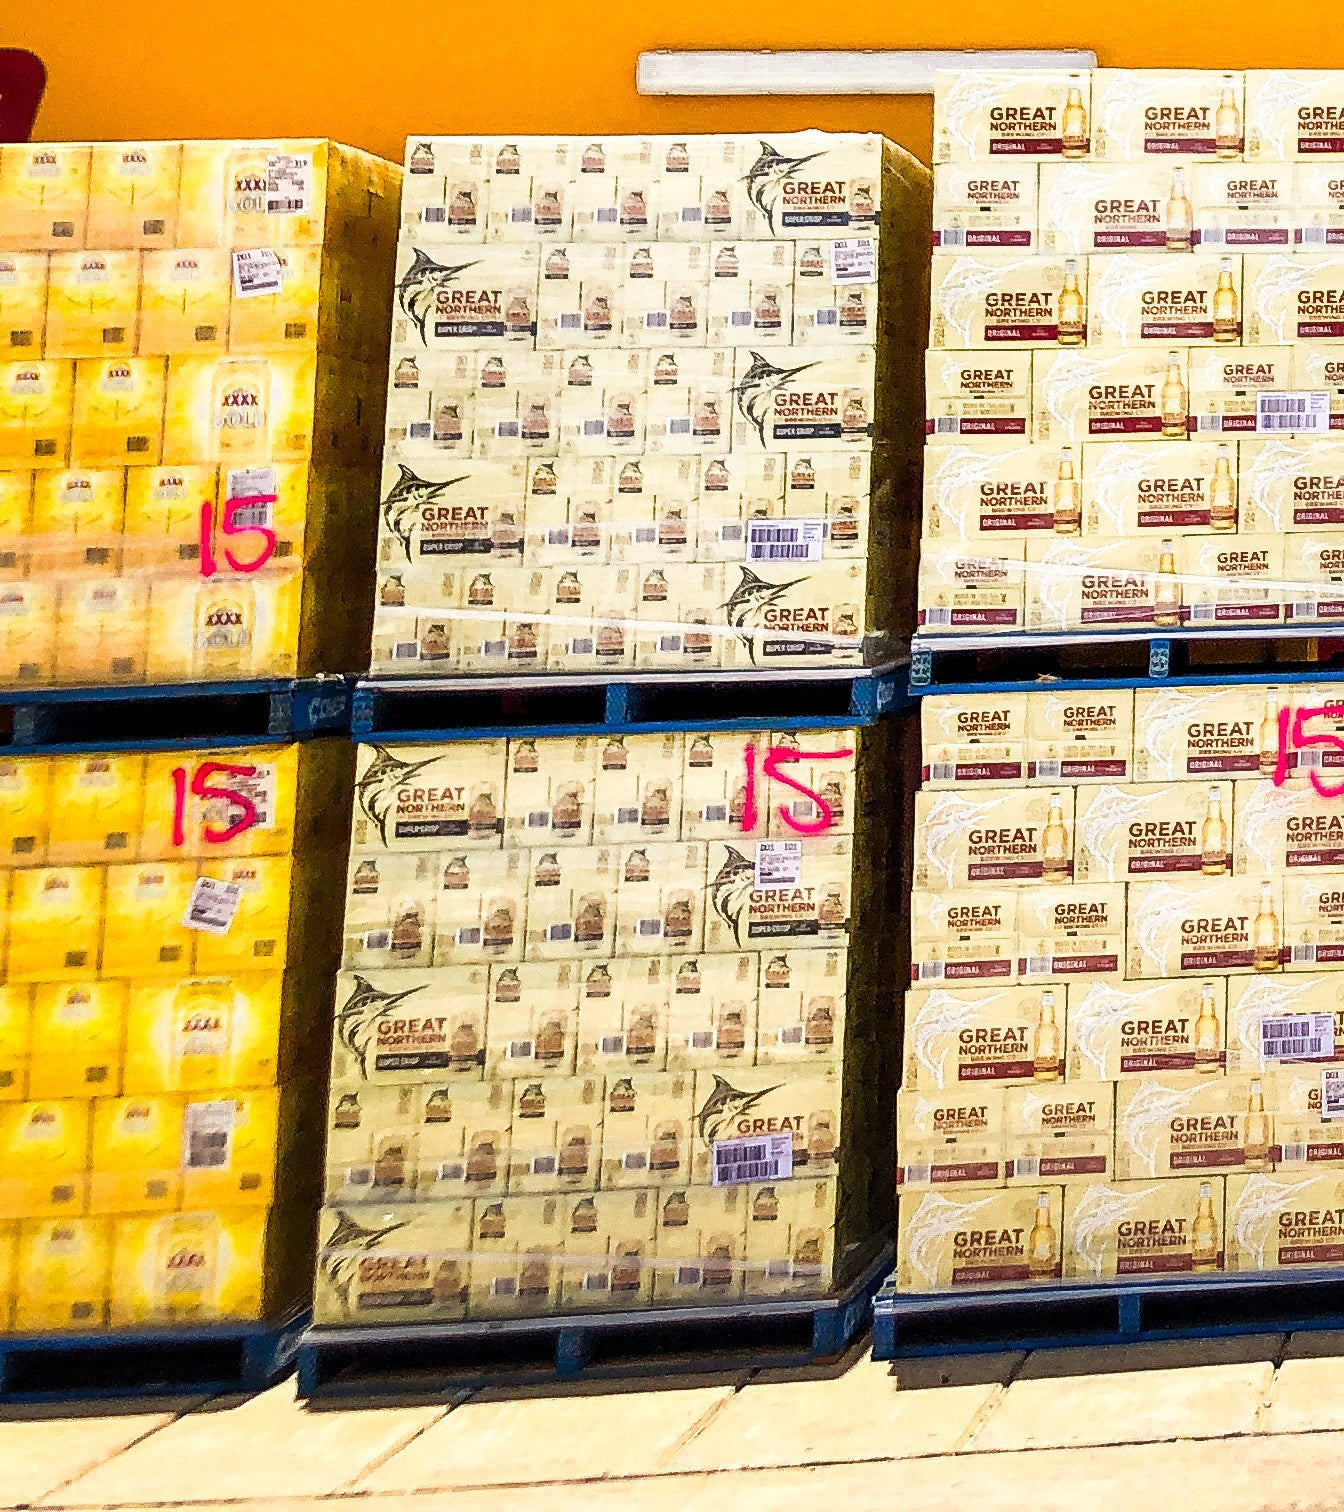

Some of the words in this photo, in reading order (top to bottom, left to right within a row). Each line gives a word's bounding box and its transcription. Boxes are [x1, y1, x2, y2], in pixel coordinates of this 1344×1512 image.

[990, 107, 1056, 121] GREAT
[1145, 107, 1210, 121] GREAT
[990, 122, 1056, 131] NORTHERN
[1145, 122, 1210, 131] NORTHERN
[783, 181, 845, 195] GREAT
[967, 181, 1019, 191] GREAT
[783, 195, 845, 204] NORTHERN
[1094, 199, 1160, 213] GREAT
[1094, 215, 1160, 224] NORTHERN
[437, 291, 502, 304] GREAT
[986, 292, 1052, 308] GREAT
[1141, 291, 1207, 304] GREAT
[436, 305, 501, 314] NORTHERN
[985, 308, 1052, 317] NORTHERN
[1141, 306, 1207, 315] NORTHERN
[961, 369, 1013, 380] GREAT
[1223, 364, 1274, 375] GREAT
[1089, 385, 1155, 399] GREAT
[775, 392, 838, 406] GREAT
[1089, 400, 1155, 410] NORTHERN
[774, 406, 837, 416] NORTHERN
[980, 481, 1047, 496] GREAT
[1138, 478, 1204, 492] GREAT
[980, 497, 1047, 506] NORTHERN
[1138, 493, 1204, 503] NORTHERN
[421, 506, 489, 521] GREAT
[200, 494, 278, 577] 15
[1218, 552, 1269, 563] GREAT
[957, 710, 1010, 723] GREAT
[1064, 706, 1116, 718] GREAT
[1188, 722, 1254, 737] GREAT
[1188, 738, 1254, 748] NORTHERN
[397, 787, 465, 803] GREAT
[741, 744, 853, 834] 15
[172, 762, 256, 846] 15
[397, 802, 465, 813] NORTHERN
[969, 828, 1037, 843] GREAT
[1129, 822, 1196, 837] GREAT
[1129, 838, 1196, 848] NORTHERN
[969, 845, 1037, 855] NORTHERN
[750, 887, 815, 903] GREAT
[749, 903, 815, 913] NORTHERN
[948, 906, 1001, 918] GREAT
[1055, 903, 1107, 915] GREAT
[1181, 917, 1248, 932] GREAT
[1181, 934, 1248, 944] NORTHERN
[1121, 1019, 1189, 1034] GREAT
[959, 1027, 1028, 1043] GREAT
[1121, 1035, 1189, 1045] NORTHERN
[959, 1045, 1028, 1054] NORTHERN
[1042, 1102, 1095, 1115] GREAT
[738, 1116, 804, 1133] GREAT
[1171, 1116, 1237, 1131] GREAT
[1170, 1132, 1238, 1142] NORTHERN
[1118, 1219, 1186, 1236] GREAT
[954, 1229, 1024, 1247] GREAT
[1118, 1237, 1186, 1248] NORTHERN
